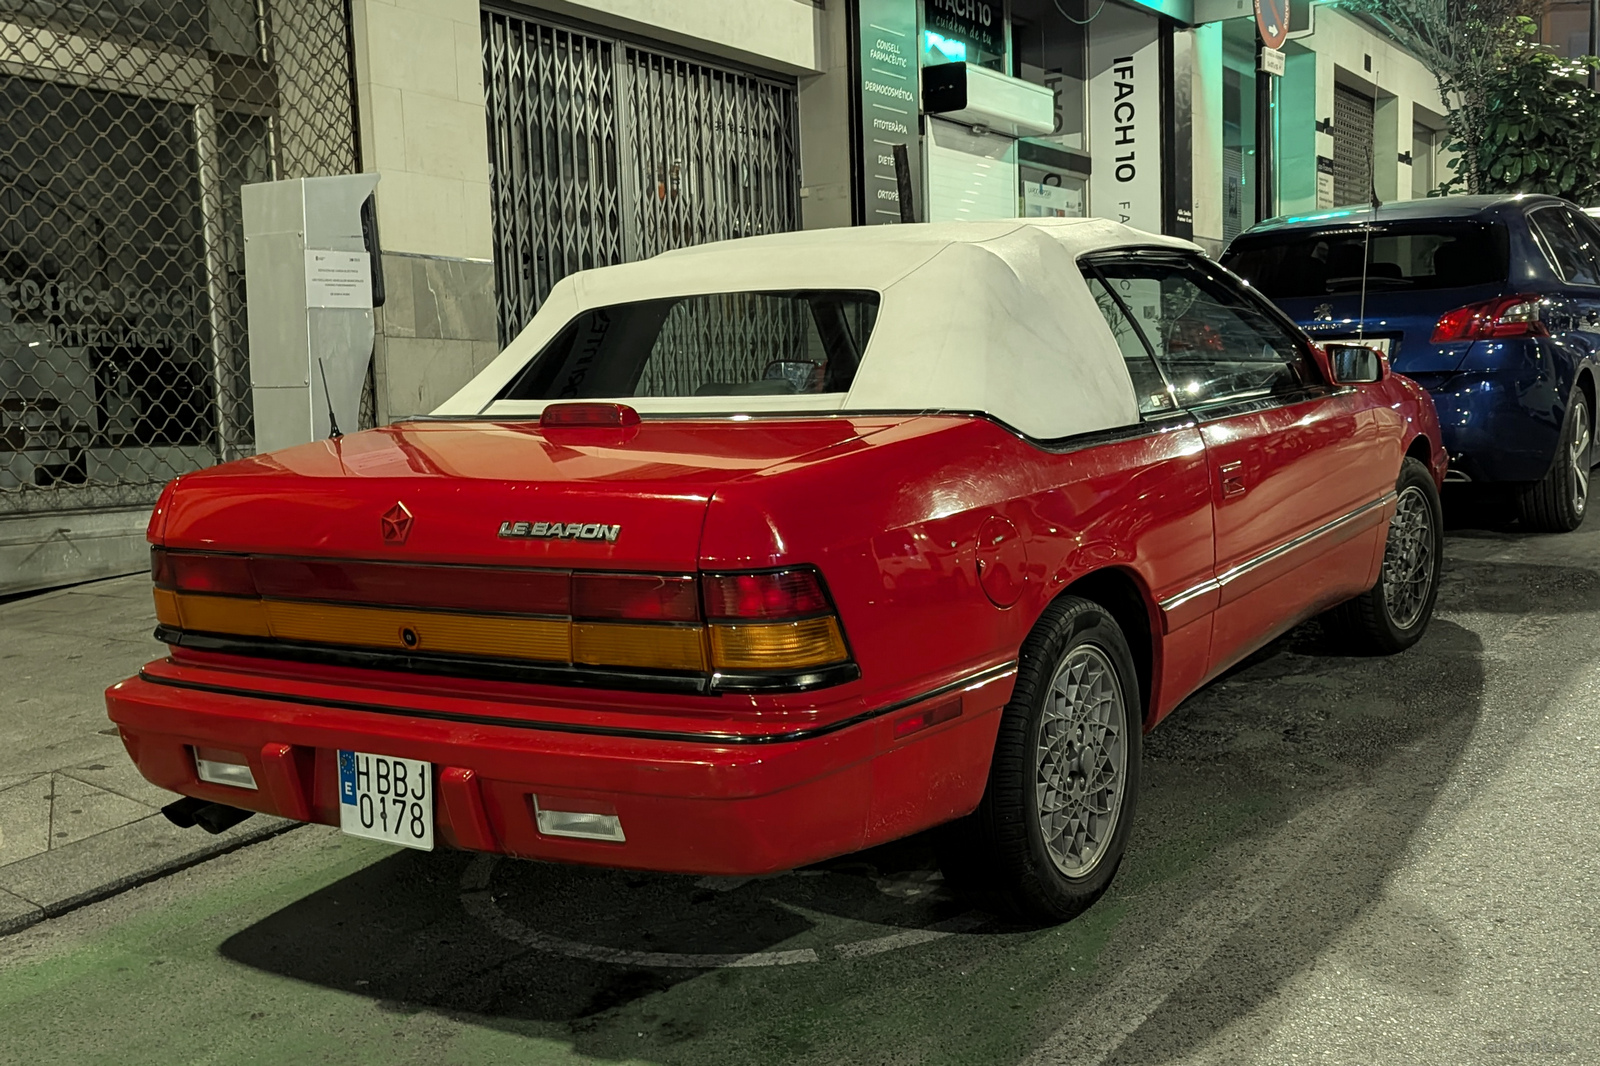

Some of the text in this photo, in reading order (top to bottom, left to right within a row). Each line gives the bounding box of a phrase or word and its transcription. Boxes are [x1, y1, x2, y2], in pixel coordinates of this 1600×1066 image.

[978, 1, 991, 27] 10
[936, 15, 992, 46] cuidem de tu
[876, 39, 901, 54] CONSELL
[870, 49, 907, 68] FARMACÈUTIC
[865, 80, 914, 102] DERMOCOSMÉTICA
[873, 118, 908, 135] FITOTERÀPIA
[1113, 56, 1136, 224] IFACH 10 FA
[877, 154, 896, 166] DIETÈ
[877, 189, 900, 202] ORTOPÈ
[498, 521, 621, 541] LE BARON
[356, 755, 425, 800] HBBJ
[344, 781, 353, 796] E
[360, 793, 425, 838] 0178
